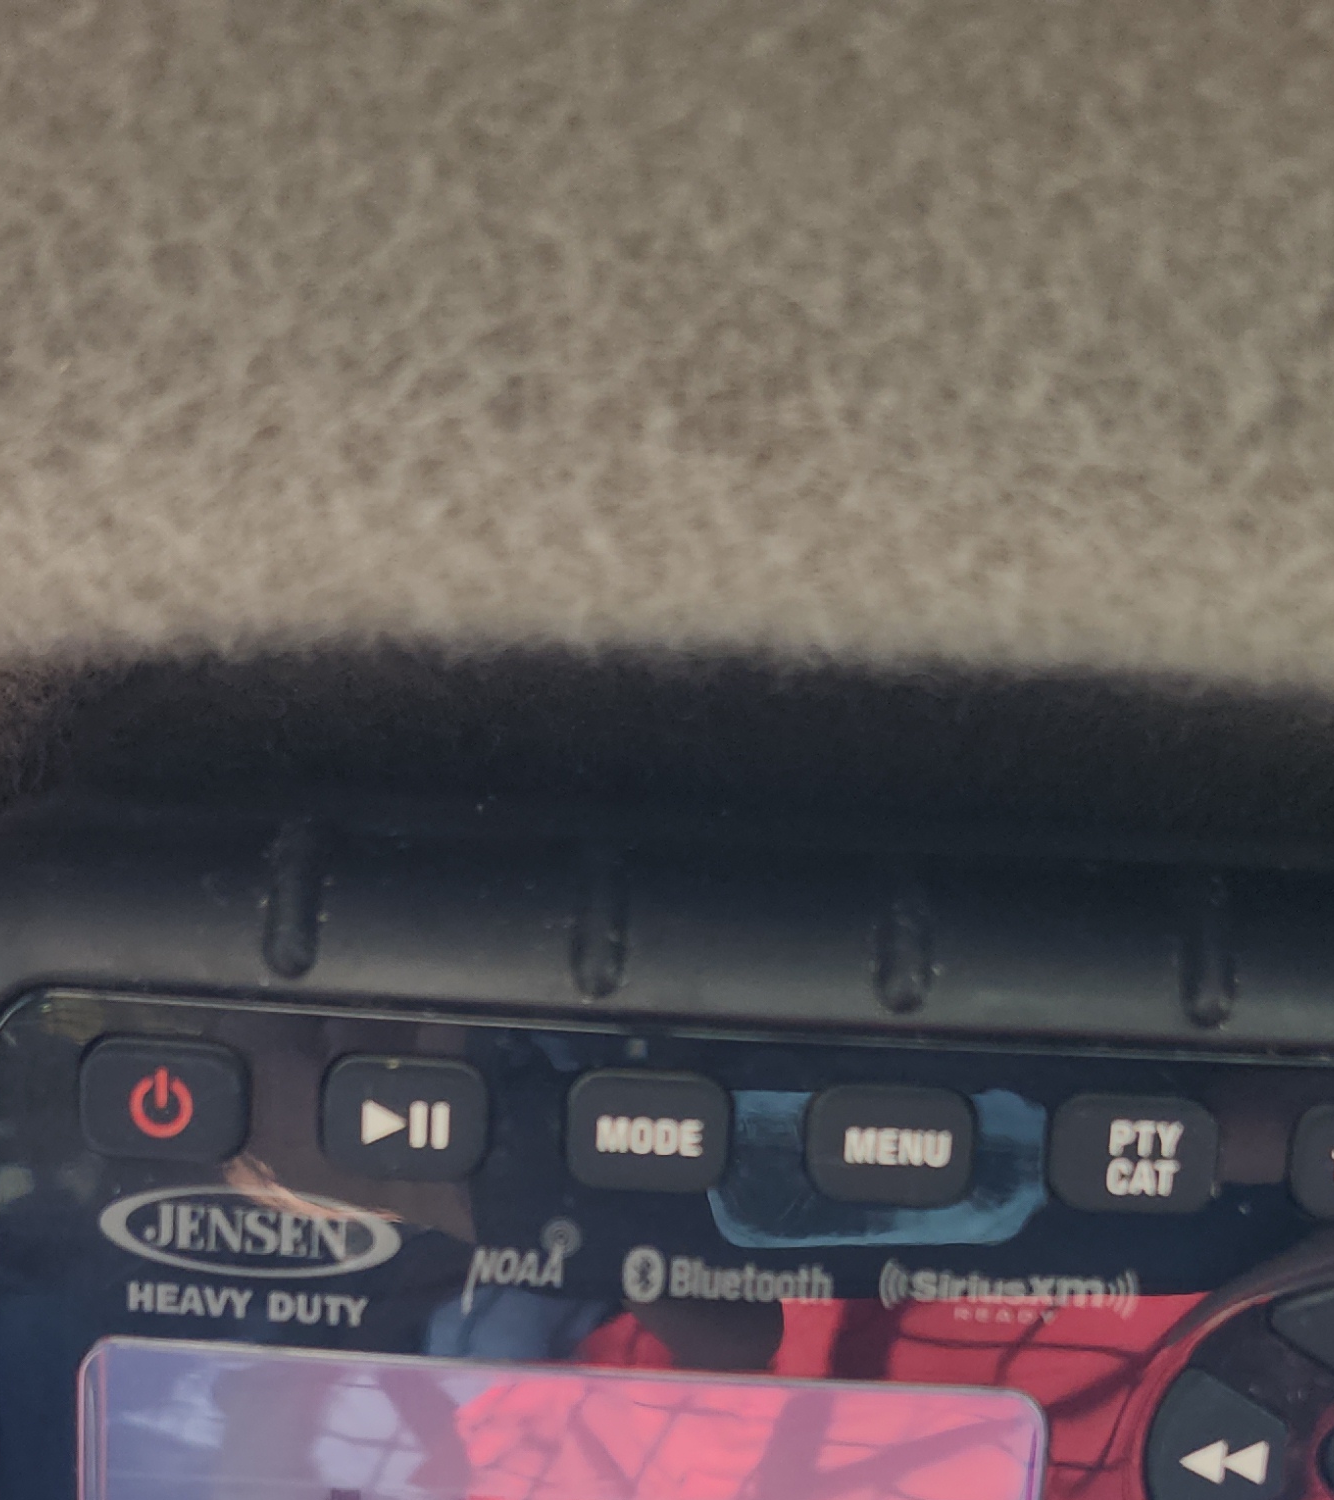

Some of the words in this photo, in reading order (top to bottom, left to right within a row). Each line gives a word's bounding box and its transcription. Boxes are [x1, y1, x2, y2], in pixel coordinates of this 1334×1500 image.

[596, 1114, 703, 1157] MODE
[844, 1126, 952, 1168] MENU
[1109, 1119, 1183, 1158] PTY
[1106, 1158, 1180, 1196] CAT
[144, 1203, 348, 1261] JENSEN
[462, 1242, 564, 1314] NOAA
[670, 1257, 834, 1306] Bluetooth
[127, 1281, 252, 1318] HEAVY
[268, 1290, 368, 1327] DUTY
[953, 1308, 1056, 1324] READY
